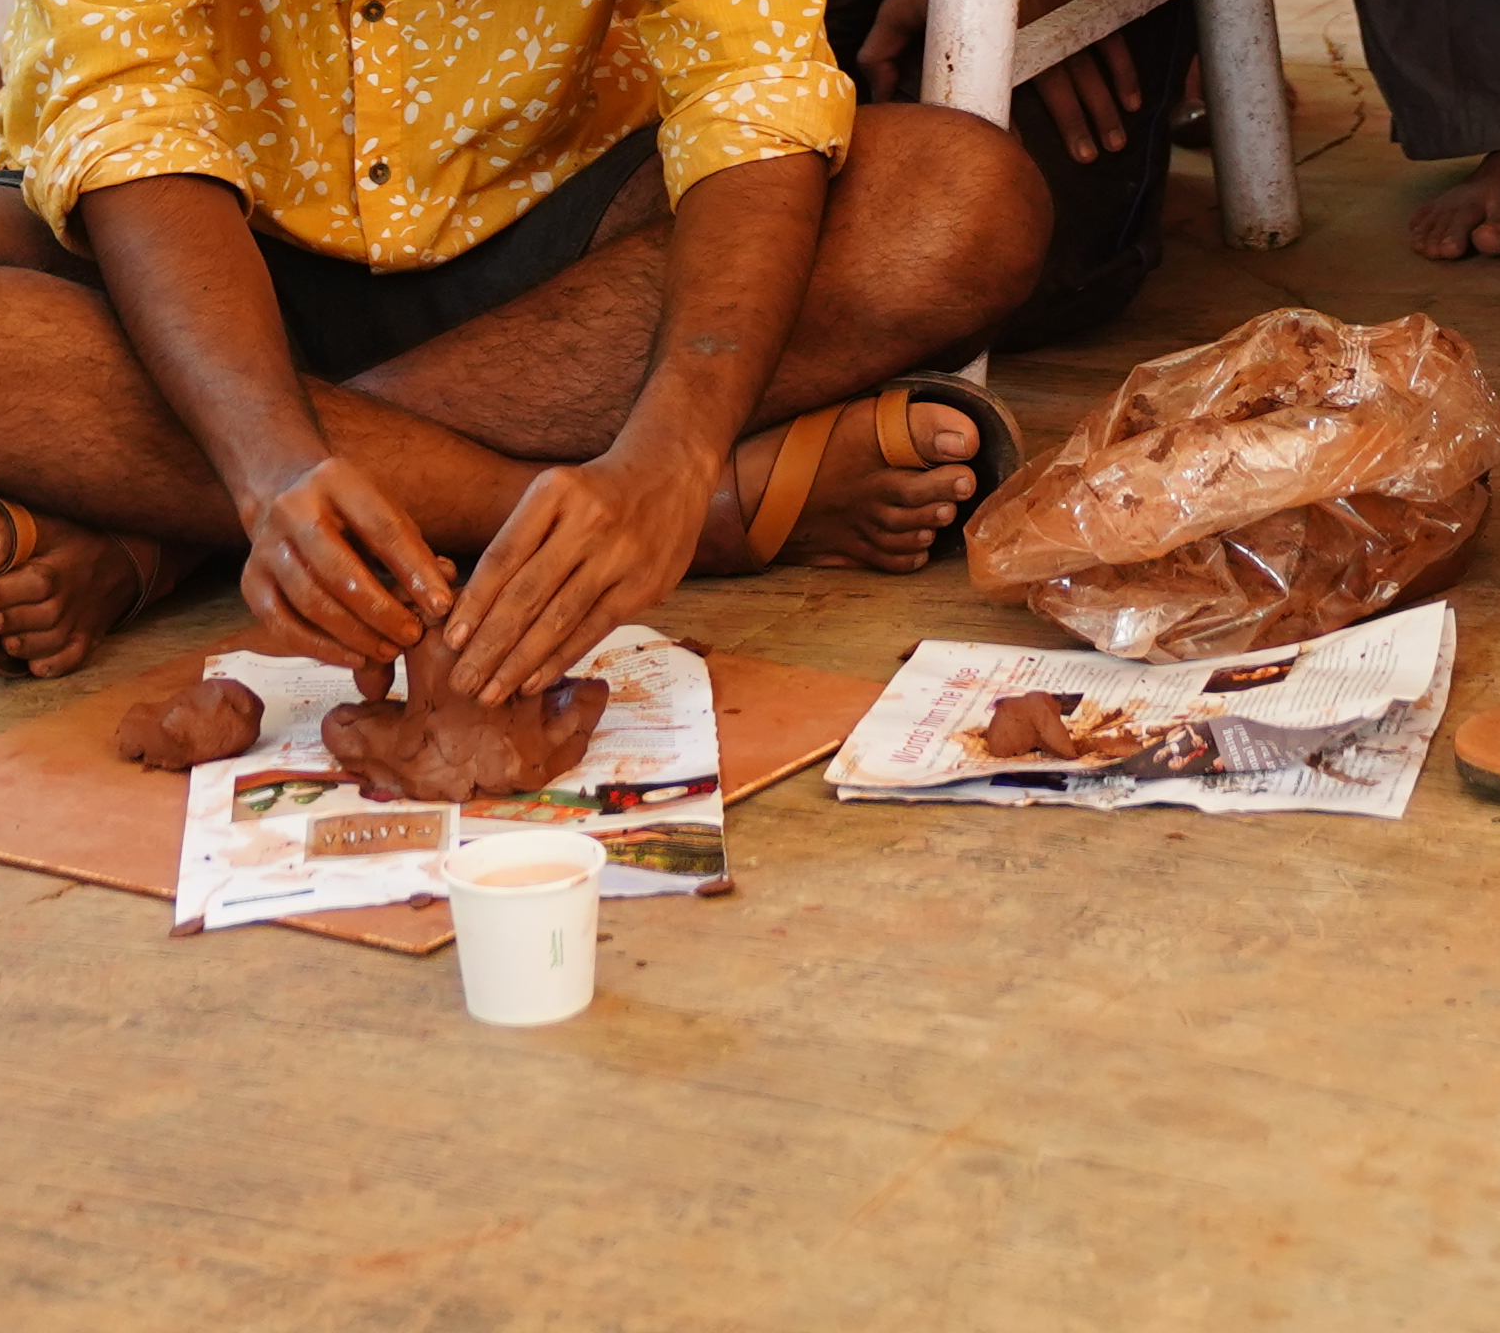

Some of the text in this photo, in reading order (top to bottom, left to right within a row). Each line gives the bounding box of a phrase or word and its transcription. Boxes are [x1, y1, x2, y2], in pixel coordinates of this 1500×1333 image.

[940, 666, 981, 690] Wise
[930, 690, 964, 707] the
[912, 708, 953, 728] from
[888, 728, 935, 764] Words
